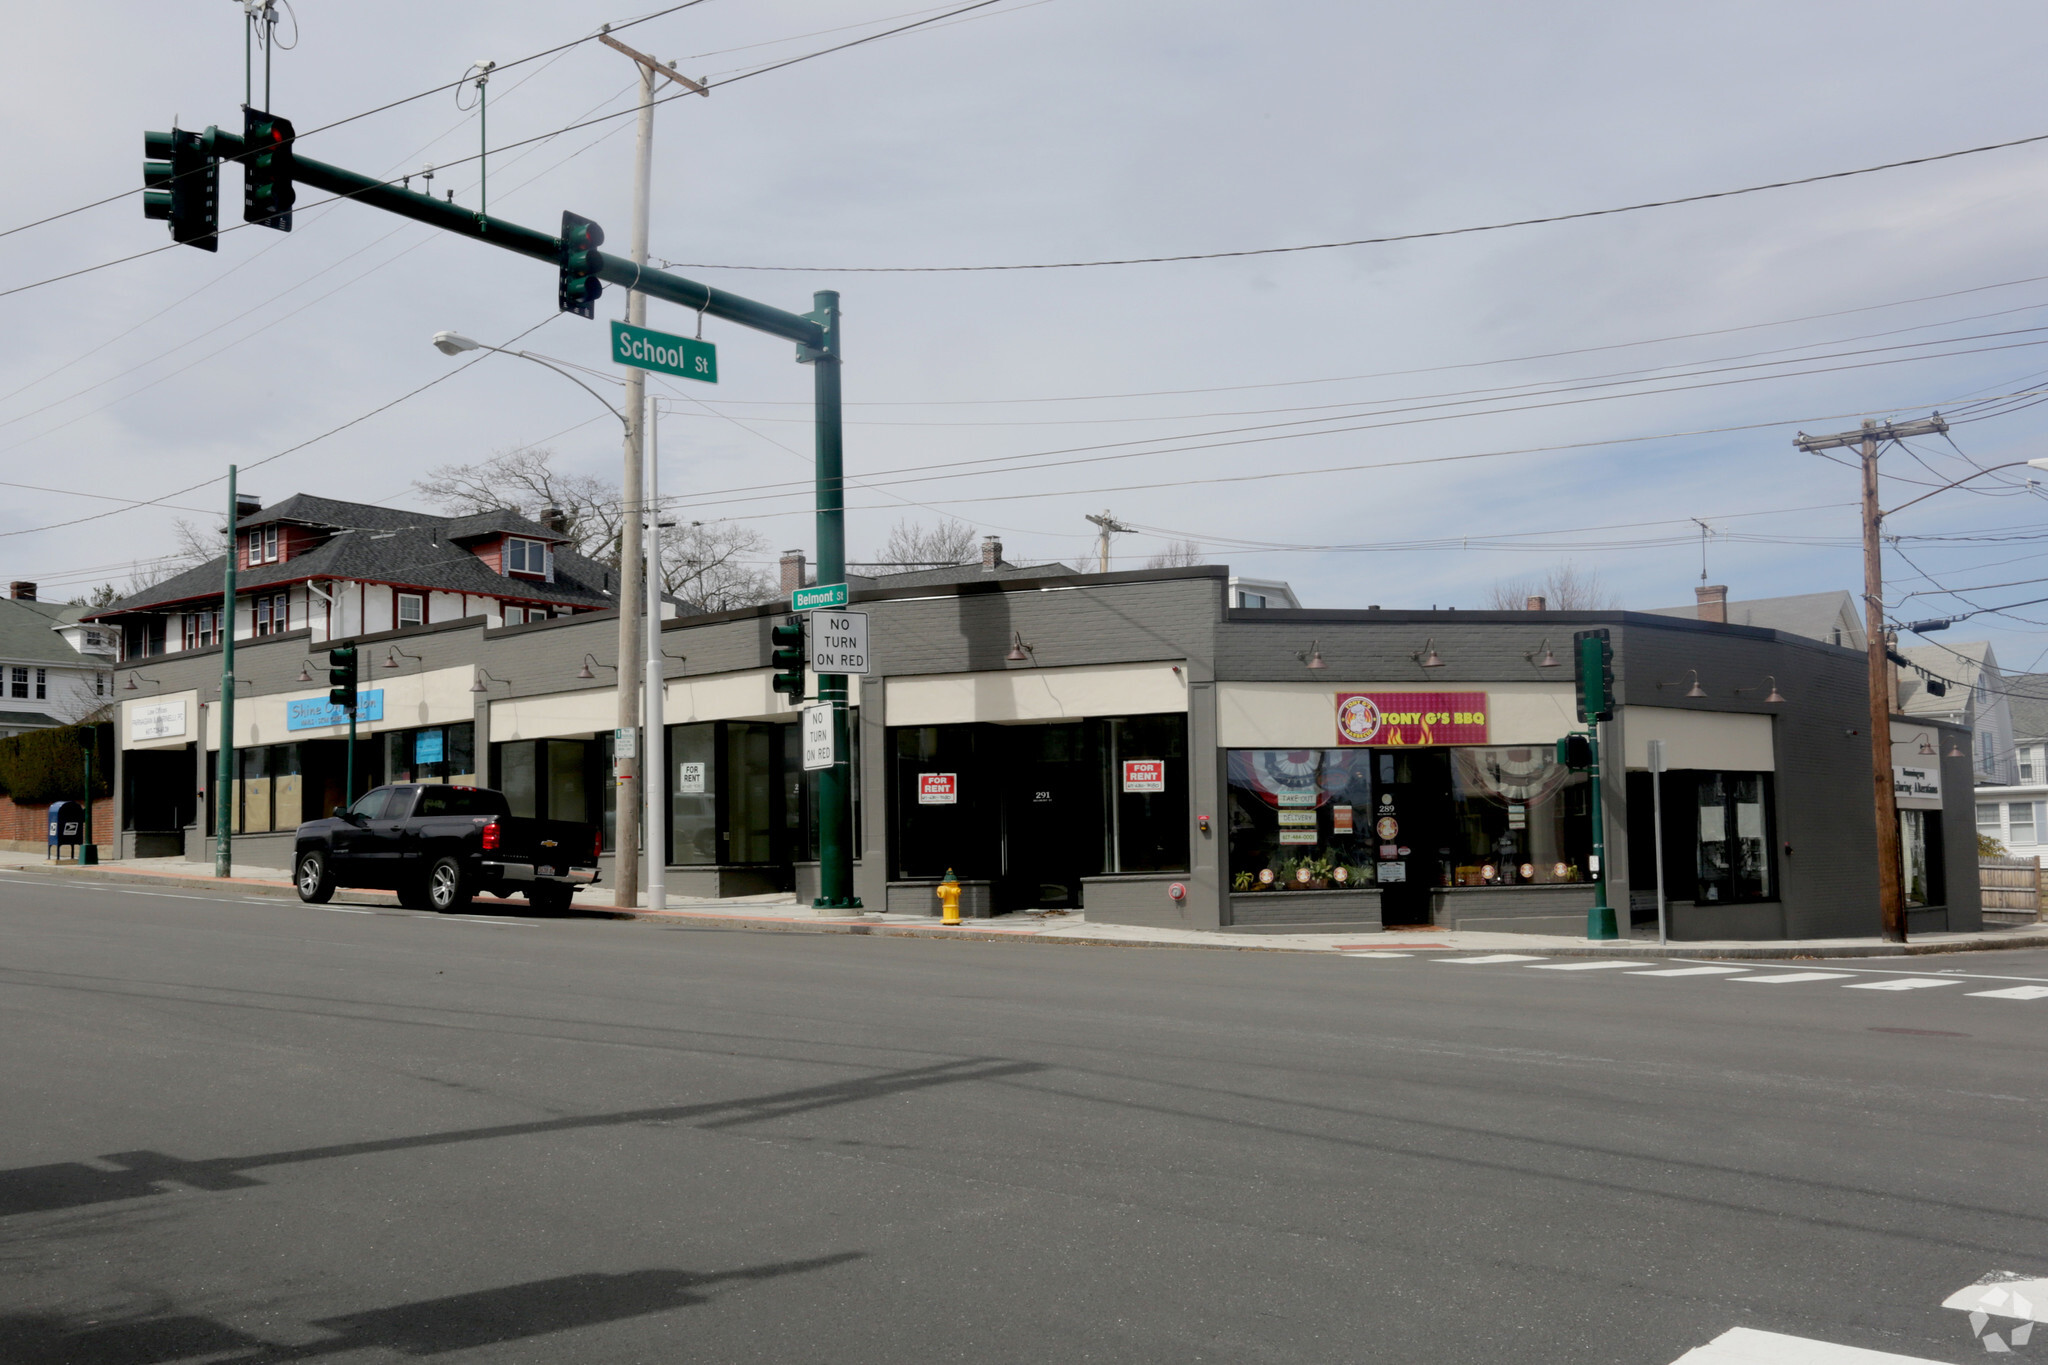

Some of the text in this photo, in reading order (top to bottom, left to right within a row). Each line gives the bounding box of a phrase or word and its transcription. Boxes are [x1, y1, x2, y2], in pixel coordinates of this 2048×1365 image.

[619, 332, 709, 374] School St
[797, 590, 844, 606] Belmont St
[830, 618, 850, 630] NO
[825, 636, 857, 648] TURN
[817, 654, 864, 666] ON RED
[292, 703, 321, 719] Shine
[812, 712, 823, 724] NO
[1380, 712, 1485, 726] TONY G'S BBQ
[810, 730, 827, 742] TURN
[807, 747, 830, 761] ON RED
[684, 774, 700, 782] RENT
[1130, 772, 1158, 780] RENT
[924, 784, 951, 792] RENT
[1035, 791, 1051, 799] 291
[1379, 805, 1395, 813] 289
